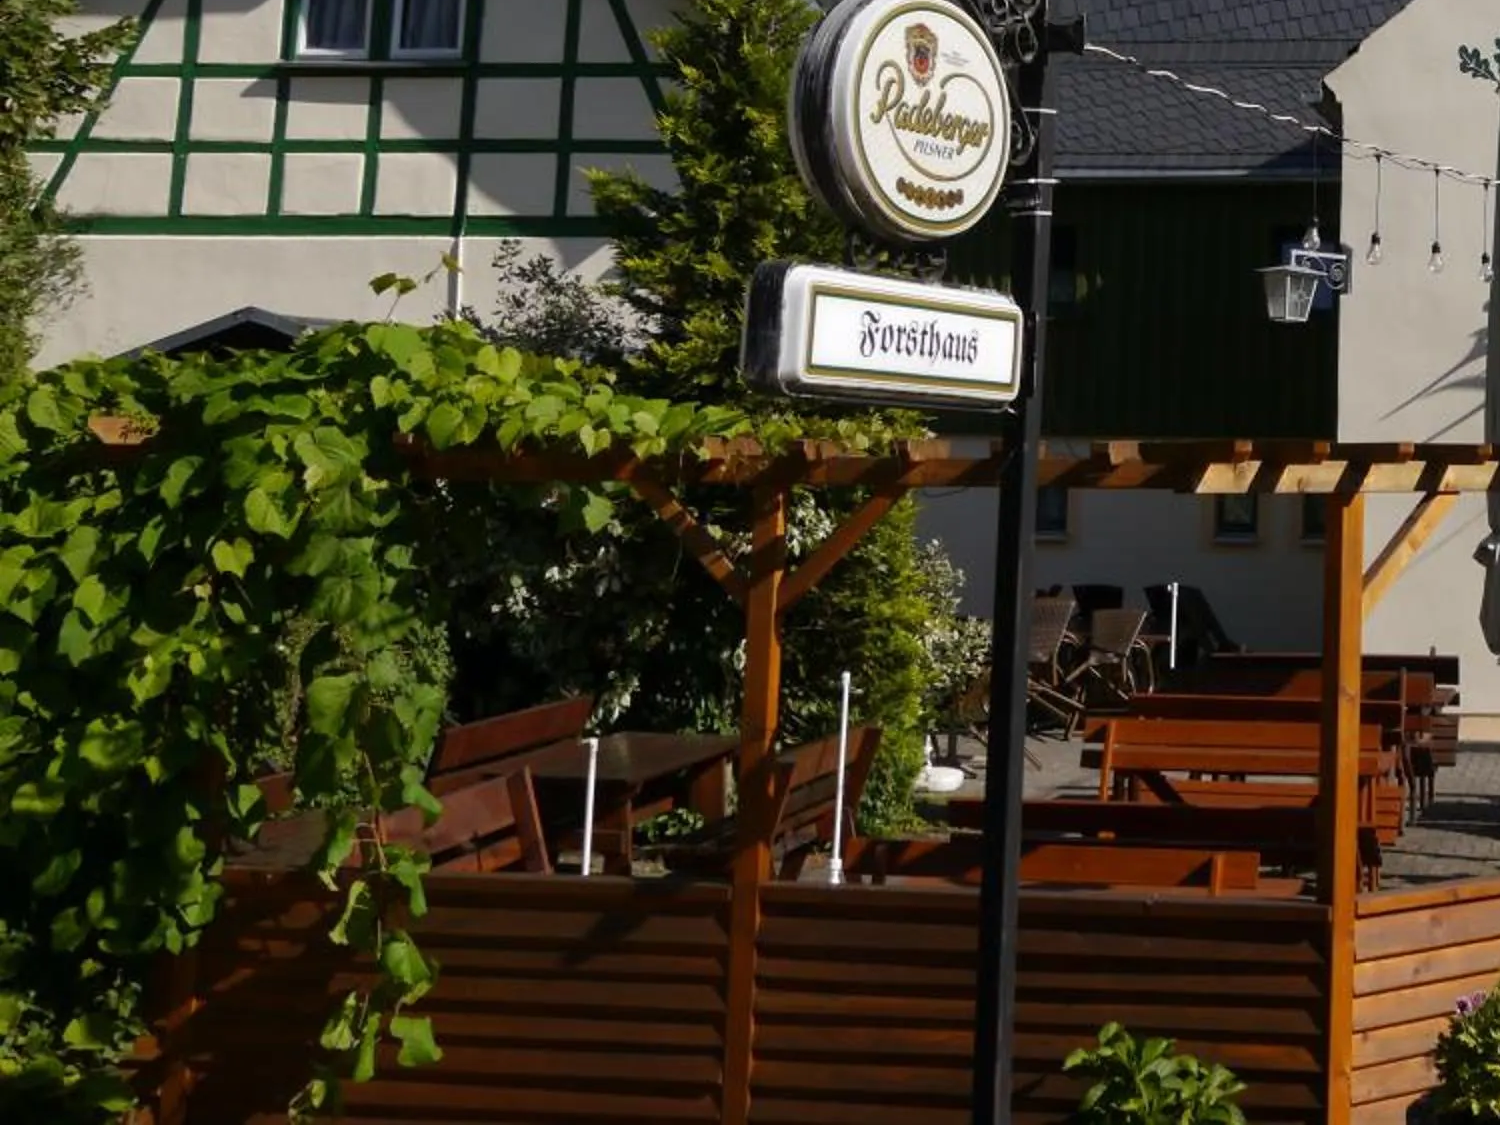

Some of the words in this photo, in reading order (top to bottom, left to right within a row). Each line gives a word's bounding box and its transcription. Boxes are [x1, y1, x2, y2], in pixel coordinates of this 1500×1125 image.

[870, 59, 990, 156] Radeberger
[913, 137, 955, 160] PILSNER
[859, 310, 979, 365] Forsthaus
